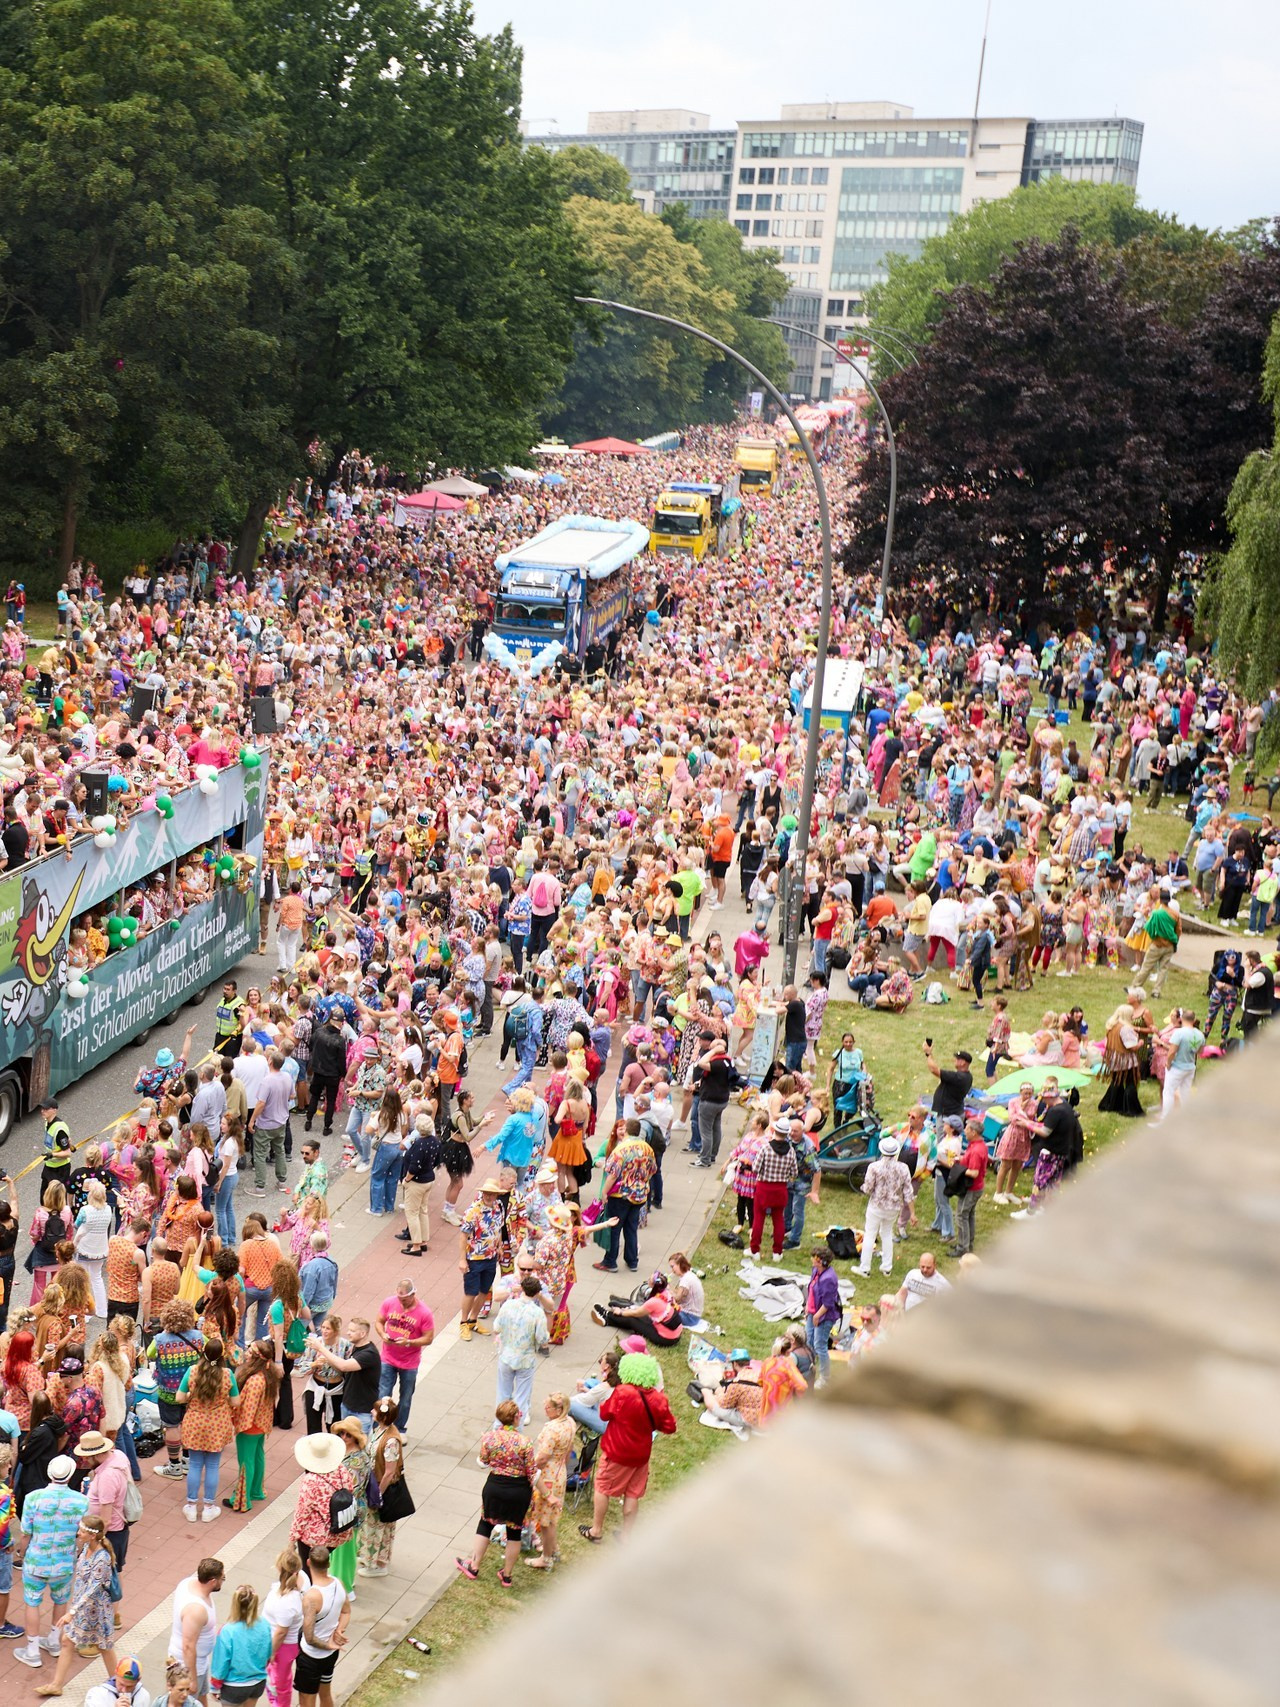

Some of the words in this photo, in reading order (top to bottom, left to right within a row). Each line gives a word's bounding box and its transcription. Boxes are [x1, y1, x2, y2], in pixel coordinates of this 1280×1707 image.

[59, 998, 87, 1042] Erst
[90, 985, 113, 1019] der
[116, 965, 154, 1003] Move,
[156, 943, 187, 974] dann
[190, 906, 227, 950] Urlaub
[77, 1032, 89, 1063] in
[91, 951, 212, 1053] Schladming-Dachstein.
